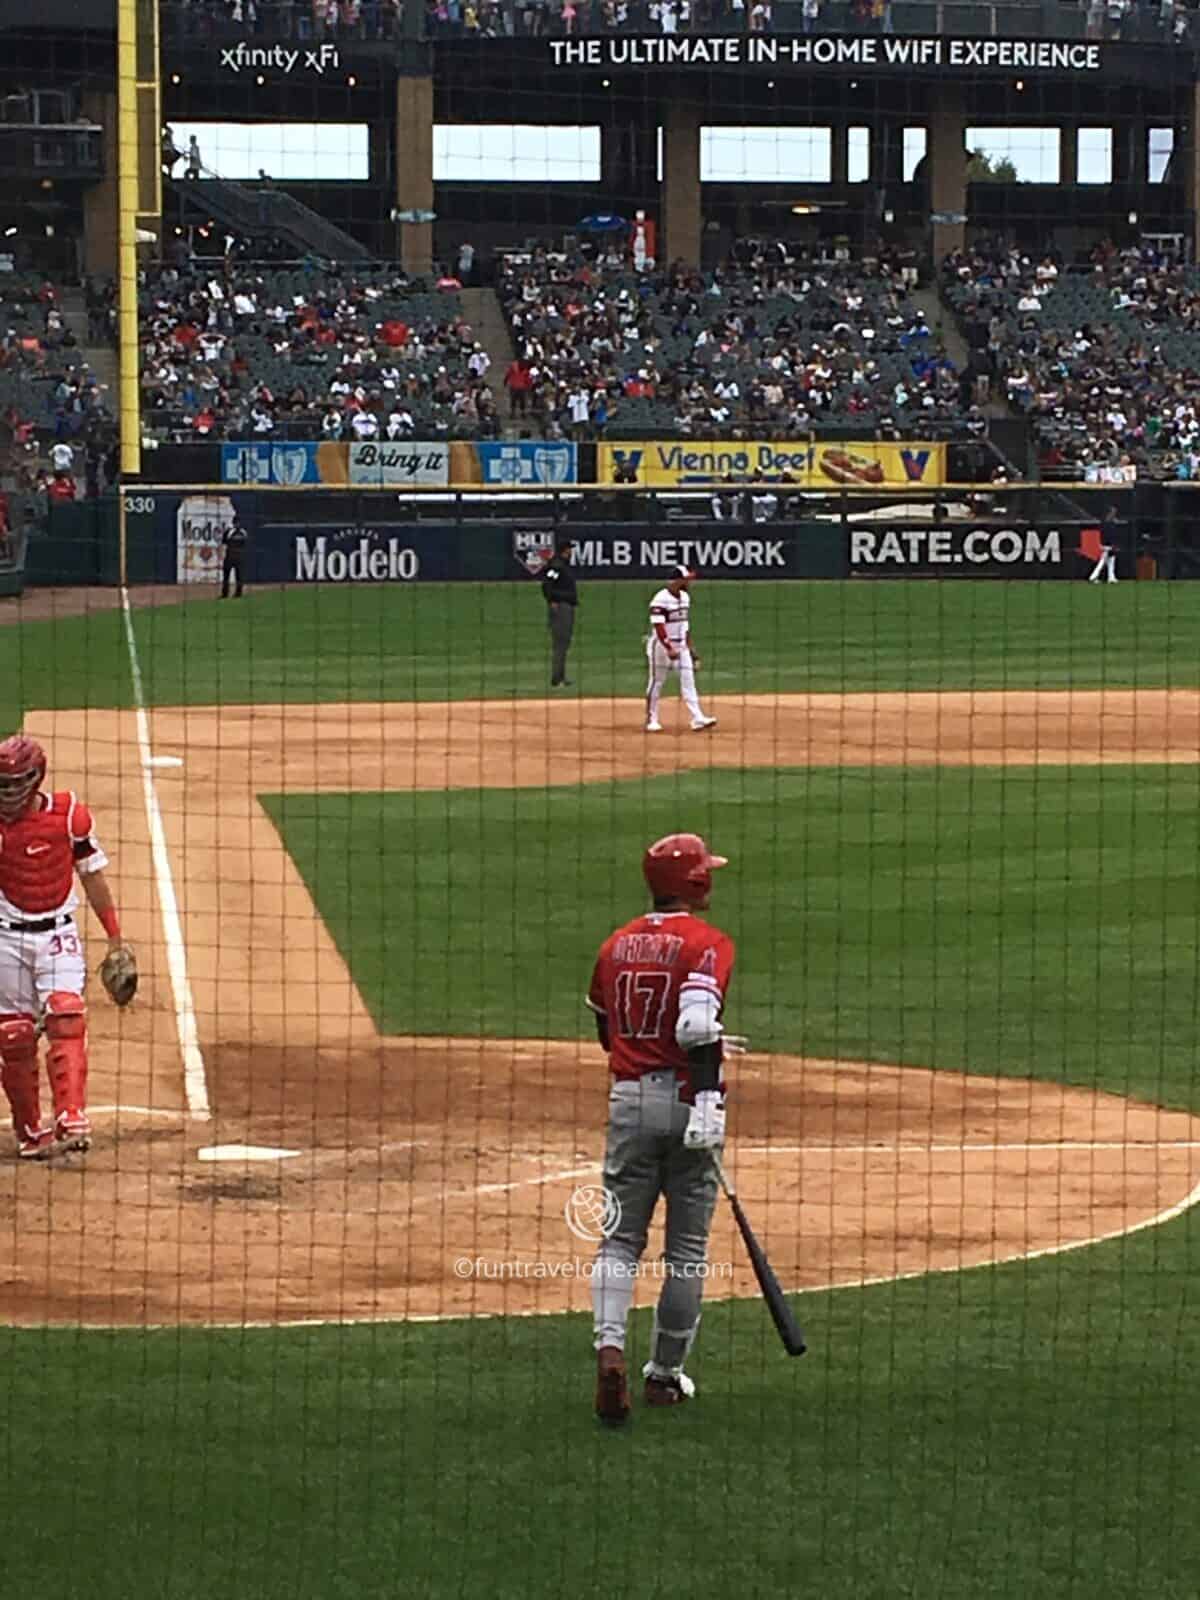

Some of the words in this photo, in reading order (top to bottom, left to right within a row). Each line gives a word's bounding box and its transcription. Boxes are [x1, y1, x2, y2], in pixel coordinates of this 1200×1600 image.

[220, 42, 299, 72] xfinity
[304, 44, 339, 74] xFi
[549, 41, 602, 65] THE
[609, 38, 741, 63] ULTIMATE
[748, 38, 877, 63] IN-HOME
[884, 39, 942, 64] WIFI
[949, 41, 1100, 68] EXPERIENCE
[354, 444, 423, 476] Bring
[425, 451, 443, 471] it
[657, 447, 749, 471] Vienna
[757, 447, 815, 471] Beef
[125, 497, 155, 512] 330
[296, 536, 418, 580] Modelo
[570, 541, 632, 566] MLB
[640, 541, 786, 566] NETWORK
[850, 530, 1062, 563] RATE.COM
[48, 934, 78, 957] 33
[615, 971, 671, 1038] 17
